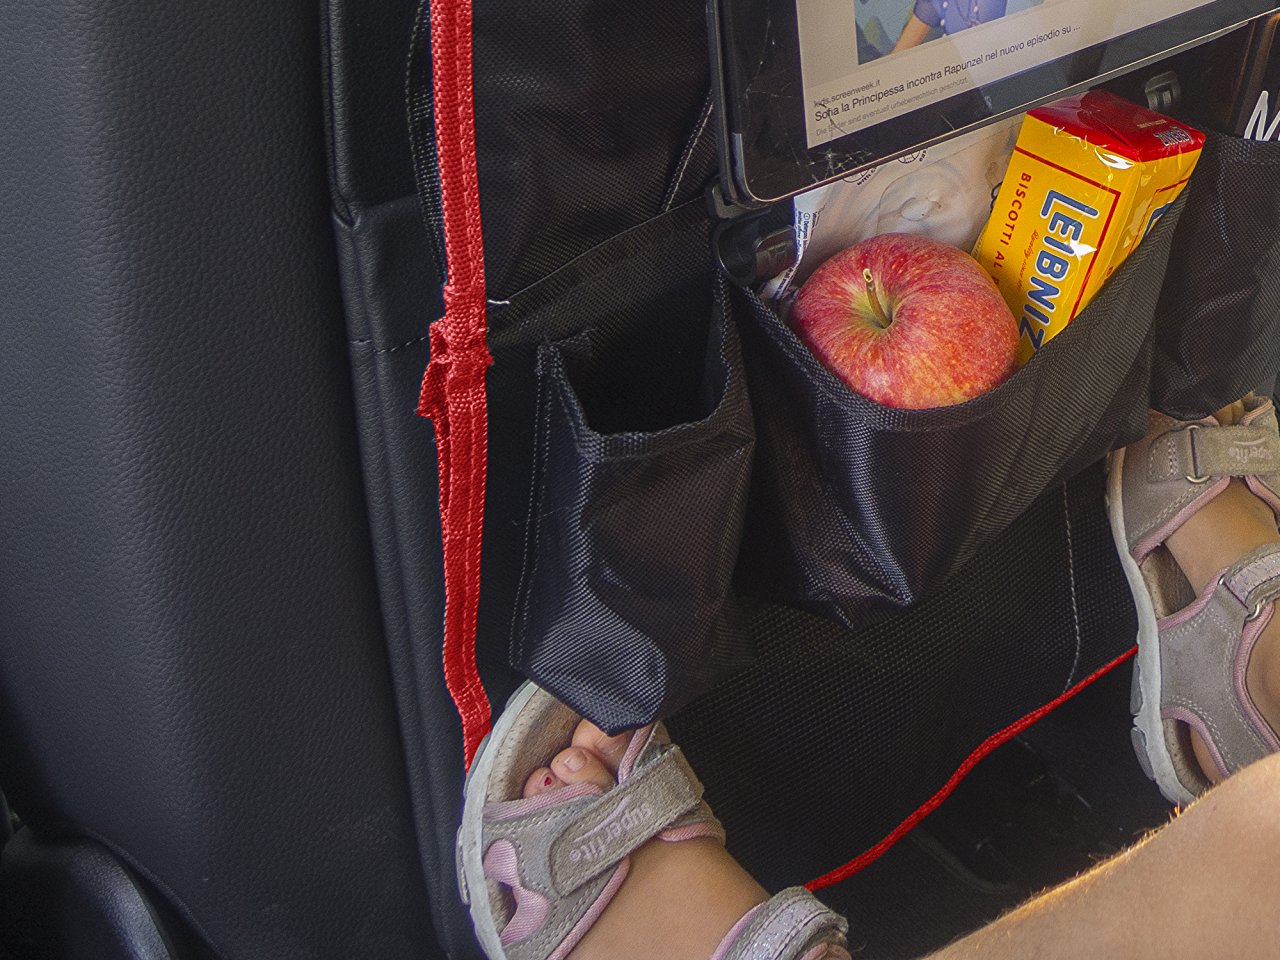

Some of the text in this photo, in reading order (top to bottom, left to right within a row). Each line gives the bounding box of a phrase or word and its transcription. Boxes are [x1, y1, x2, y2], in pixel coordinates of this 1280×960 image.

[814, 105, 839, 122] Sofia
[841, 102, 851, 113] la
[852, 84, 905, 109] Principessa
[906, 70, 943, 90] incontra
[944, 54, 984, 75] Rapunzel
[985, 49, 999, 62] nel
[999, 42, 1025, 57] nuovo
[1026, 29, 1061, 47] episodio
[1061, 25, 1072, 34] su
[1000, 172, 1032, 246] BISCOTTI
[993, 251, 1006, 269] AL
[1018, 189, 1099, 352] LEIBNIZ
